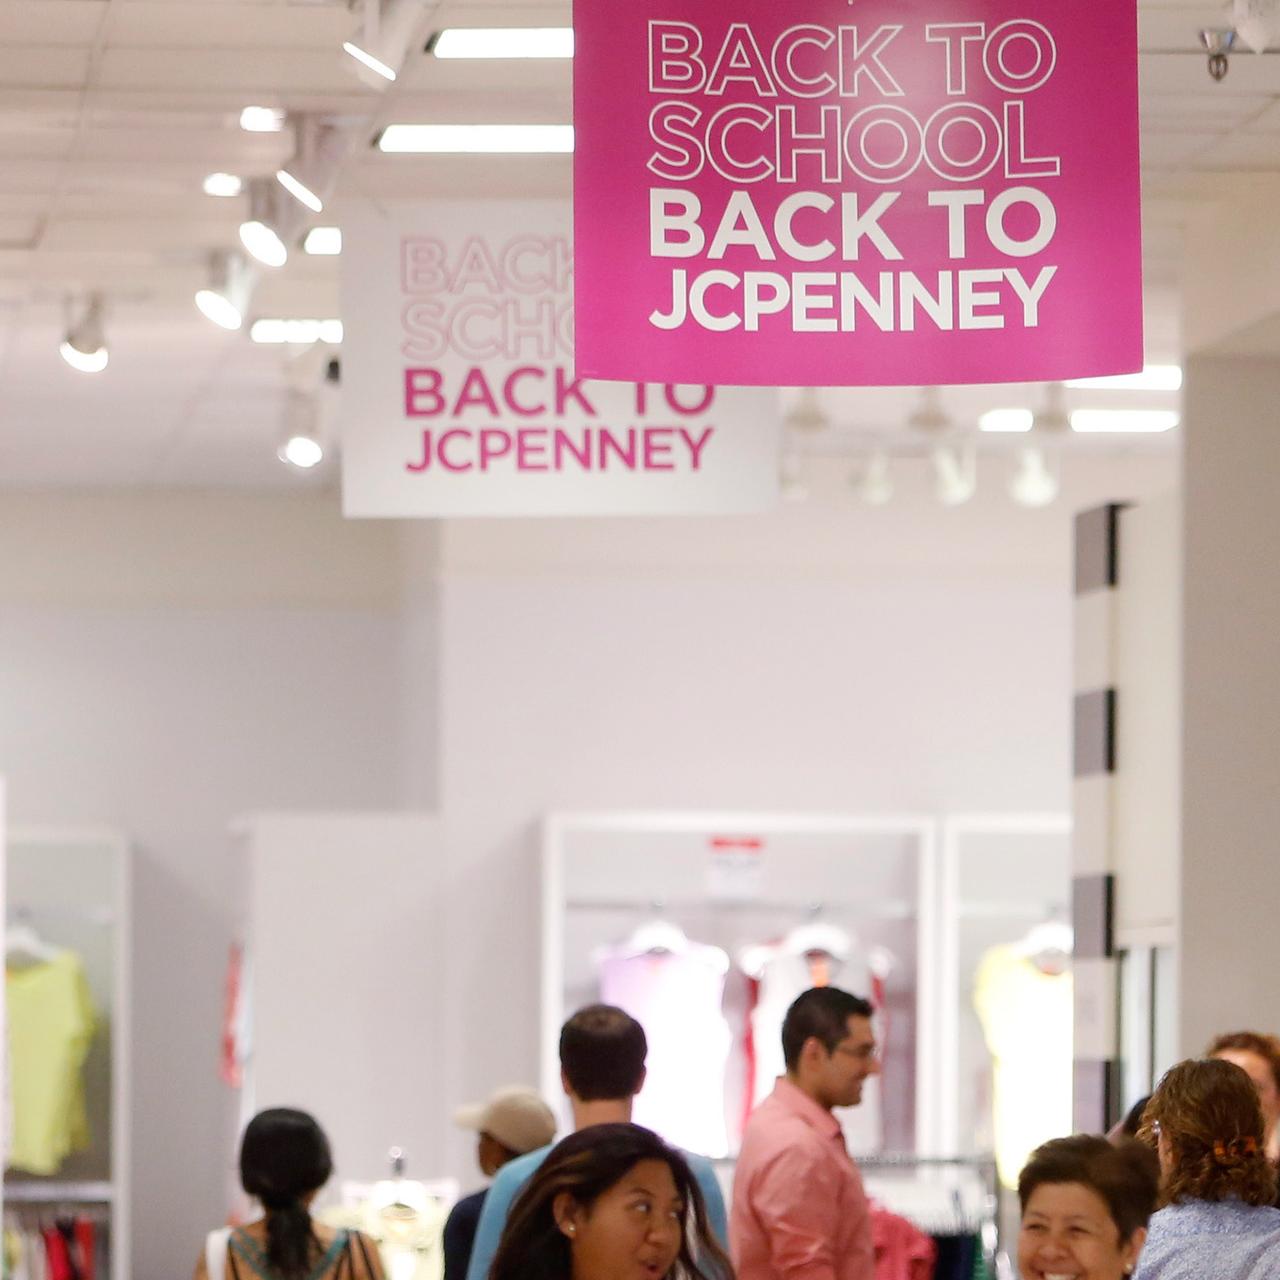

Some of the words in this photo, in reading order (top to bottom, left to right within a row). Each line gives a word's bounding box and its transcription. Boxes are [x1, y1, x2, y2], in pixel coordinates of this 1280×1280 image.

[648, 20, 905, 98] BACK
[925, 19, 1057, 95] TO
[646, 101, 1061, 184] SCHOOL
[649, 187, 905, 262] BACK
[927, 186, 1057, 258] TO
[400, 297, 574, 362] SCH
[648, 265, 1058, 332] JCPENNEY
[404, 366, 598, 418] BACK
[406, 428, 716, 472] JCPENNEY
